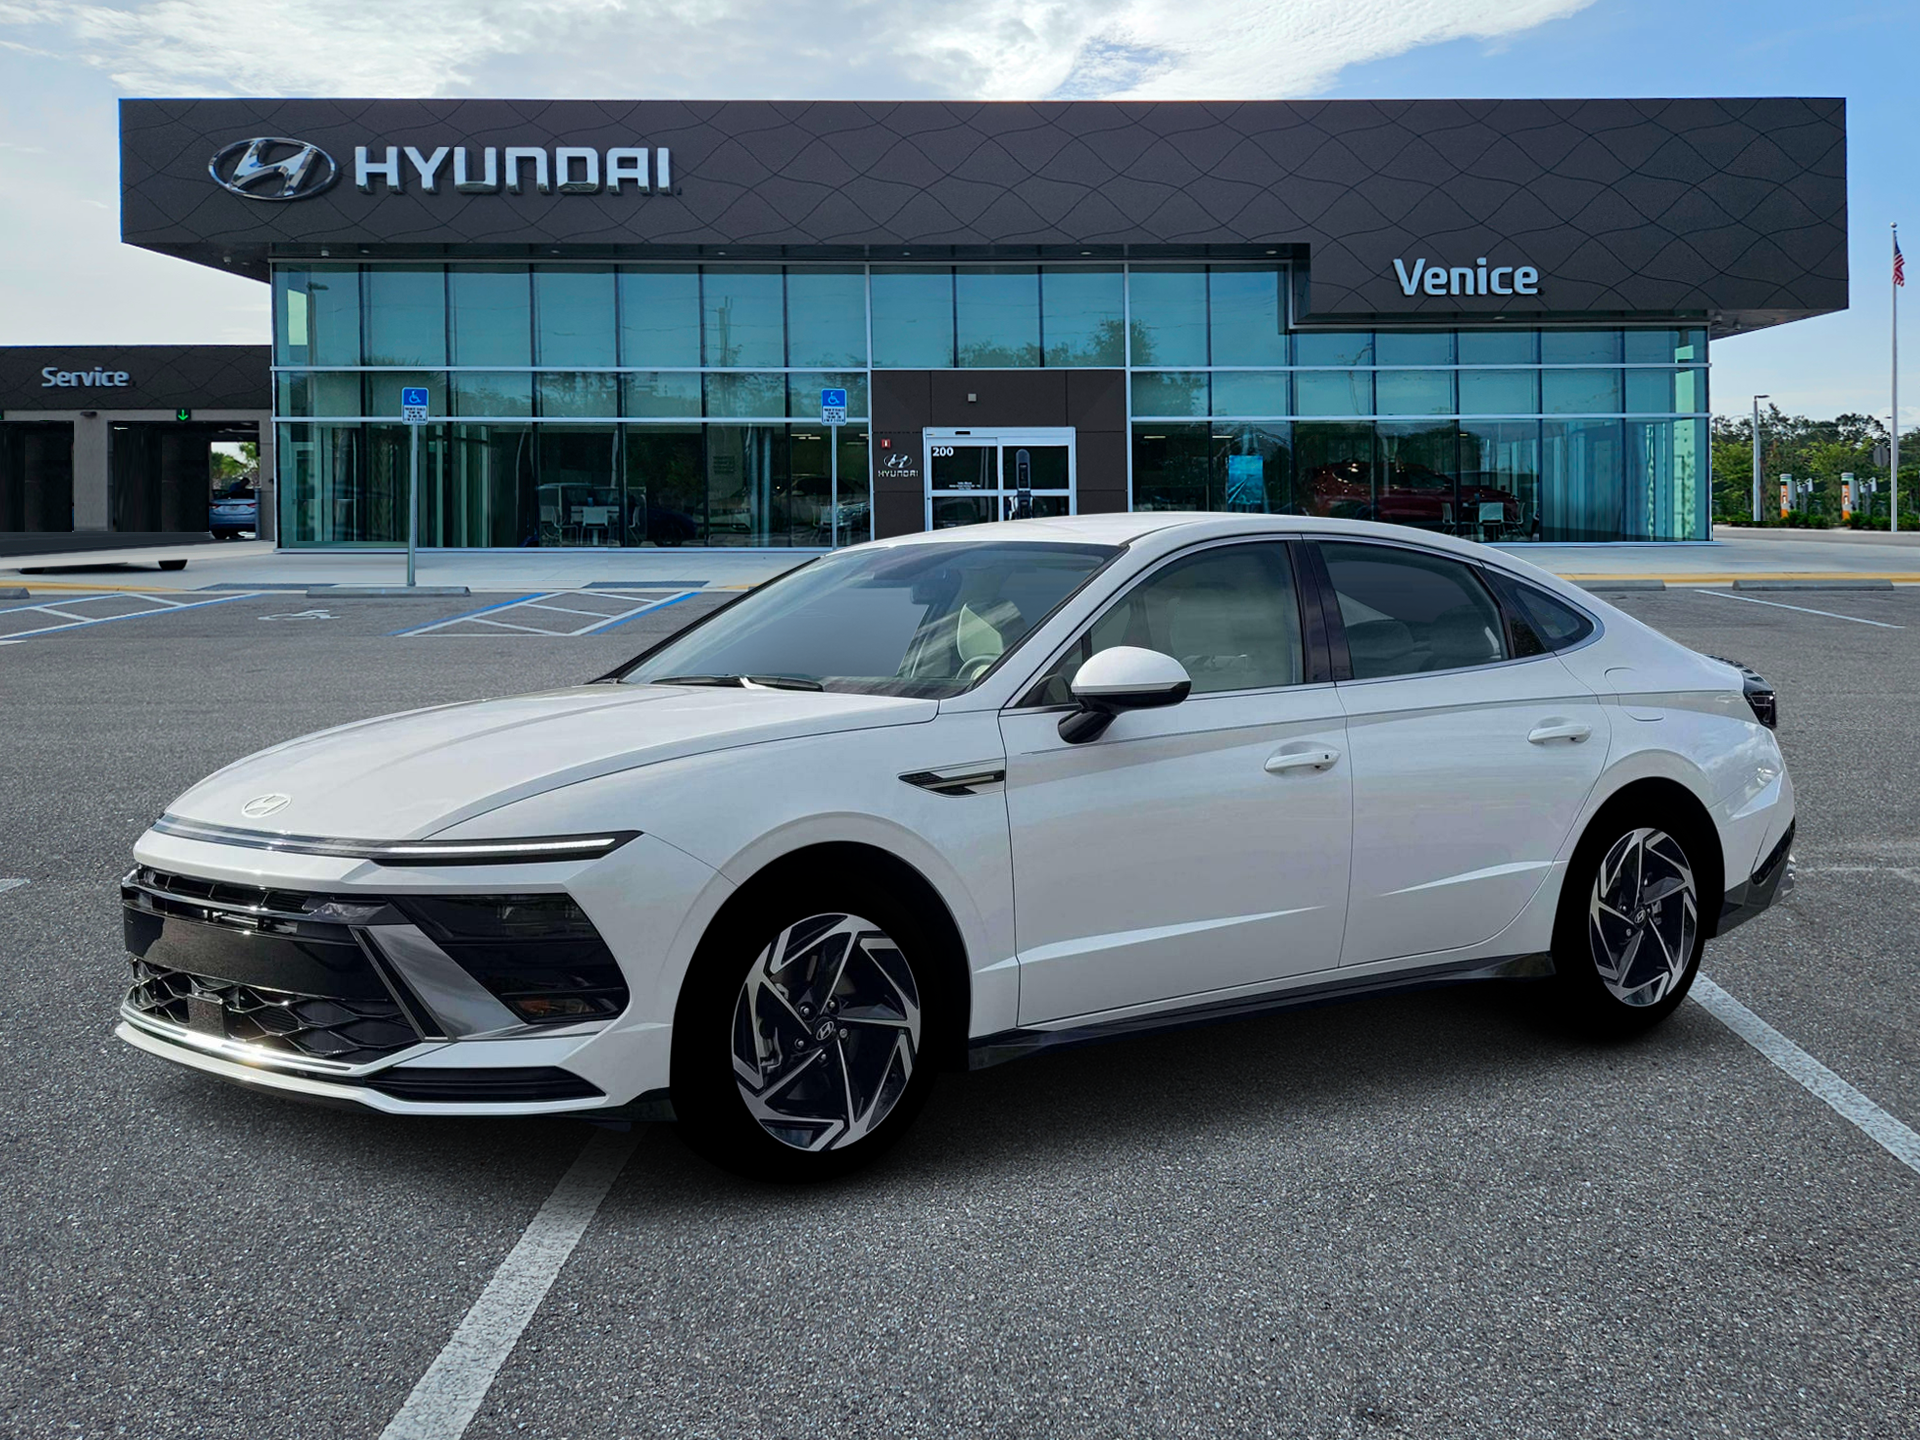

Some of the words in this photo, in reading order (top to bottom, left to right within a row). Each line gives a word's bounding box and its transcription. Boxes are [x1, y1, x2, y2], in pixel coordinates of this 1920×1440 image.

[354, 146, 675, 194] HYUNDAI
[1393, 257, 1539, 296] Venice
[41, 366, 130, 387] Service
[932, 446, 954, 457] 200
[878, 469, 918, 477] HYUNDAI
